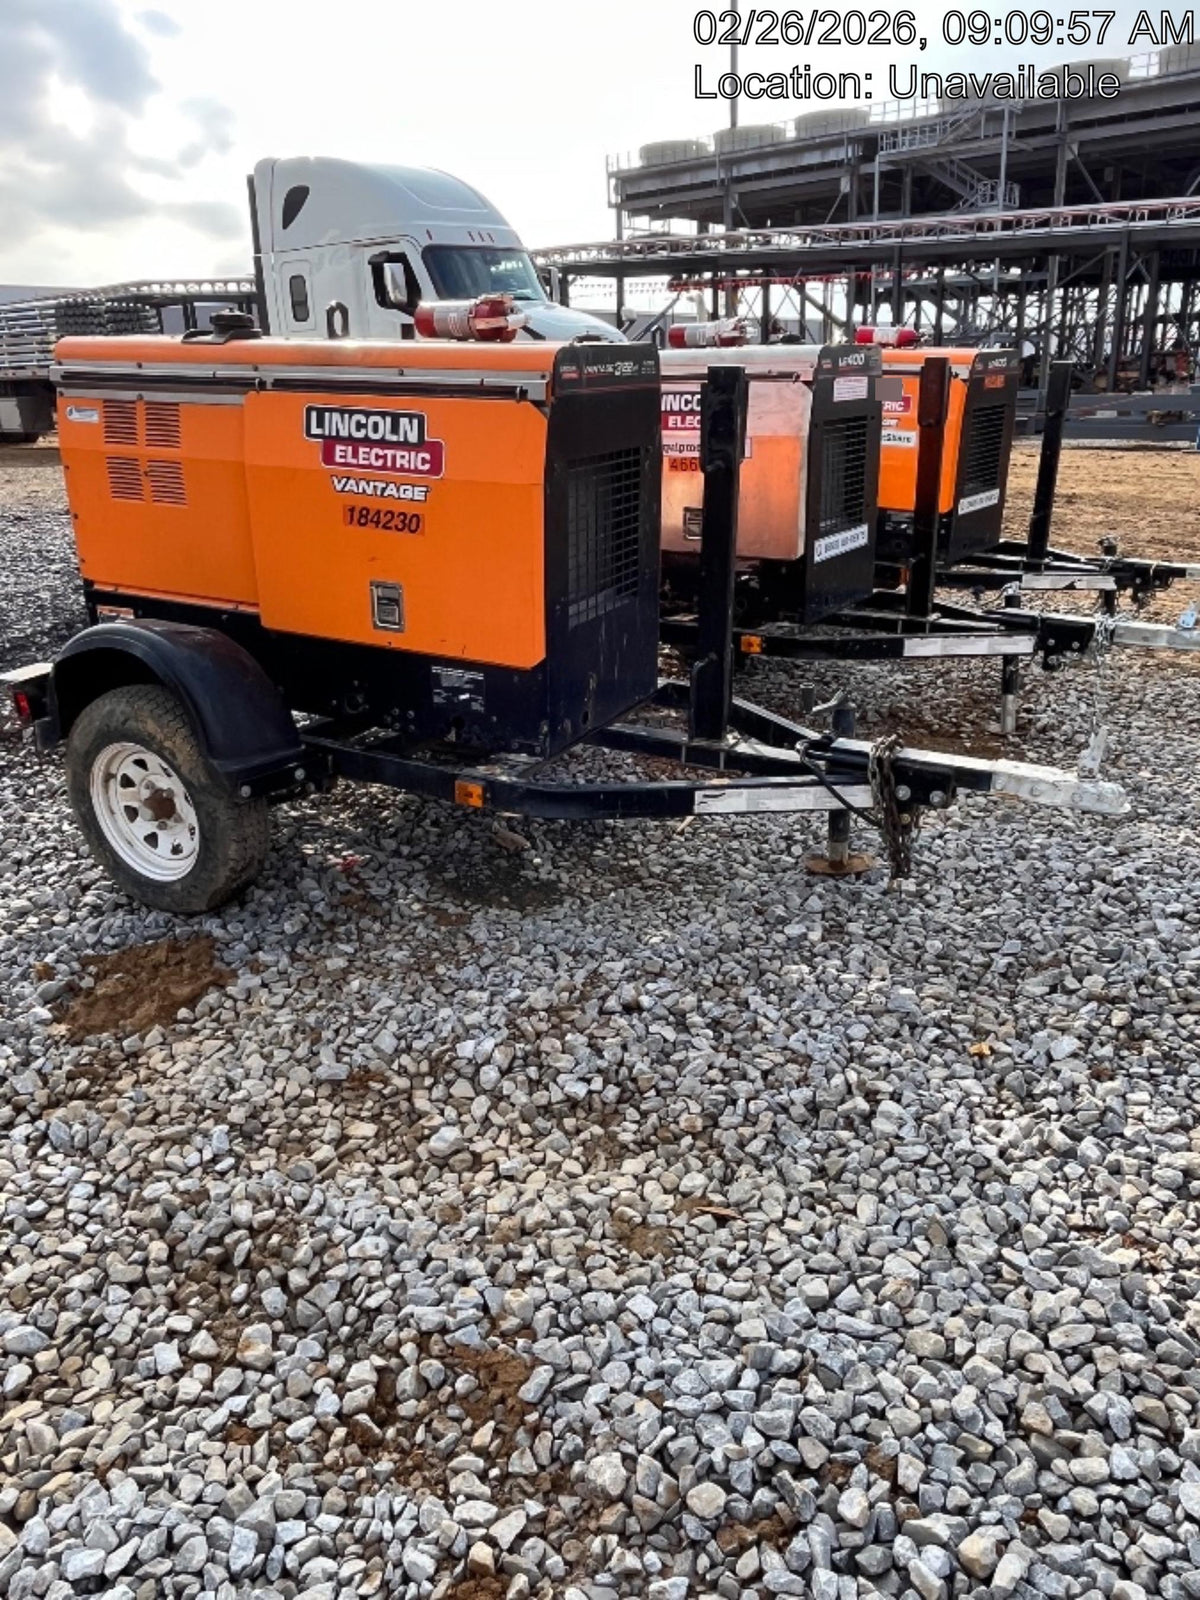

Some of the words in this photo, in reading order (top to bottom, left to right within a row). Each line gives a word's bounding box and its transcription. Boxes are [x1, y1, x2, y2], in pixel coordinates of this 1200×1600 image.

[661, 394, 701, 412] INCO
[309, 410, 419, 443] LINCOLN
[668, 415, 701, 428] ELEC
[334, 444, 432, 472] ELECTRIC
[669, 457, 699, 472] 466
[331, 475, 429, 502] VANTAGE
[346, 505, 421, 534] 184230
